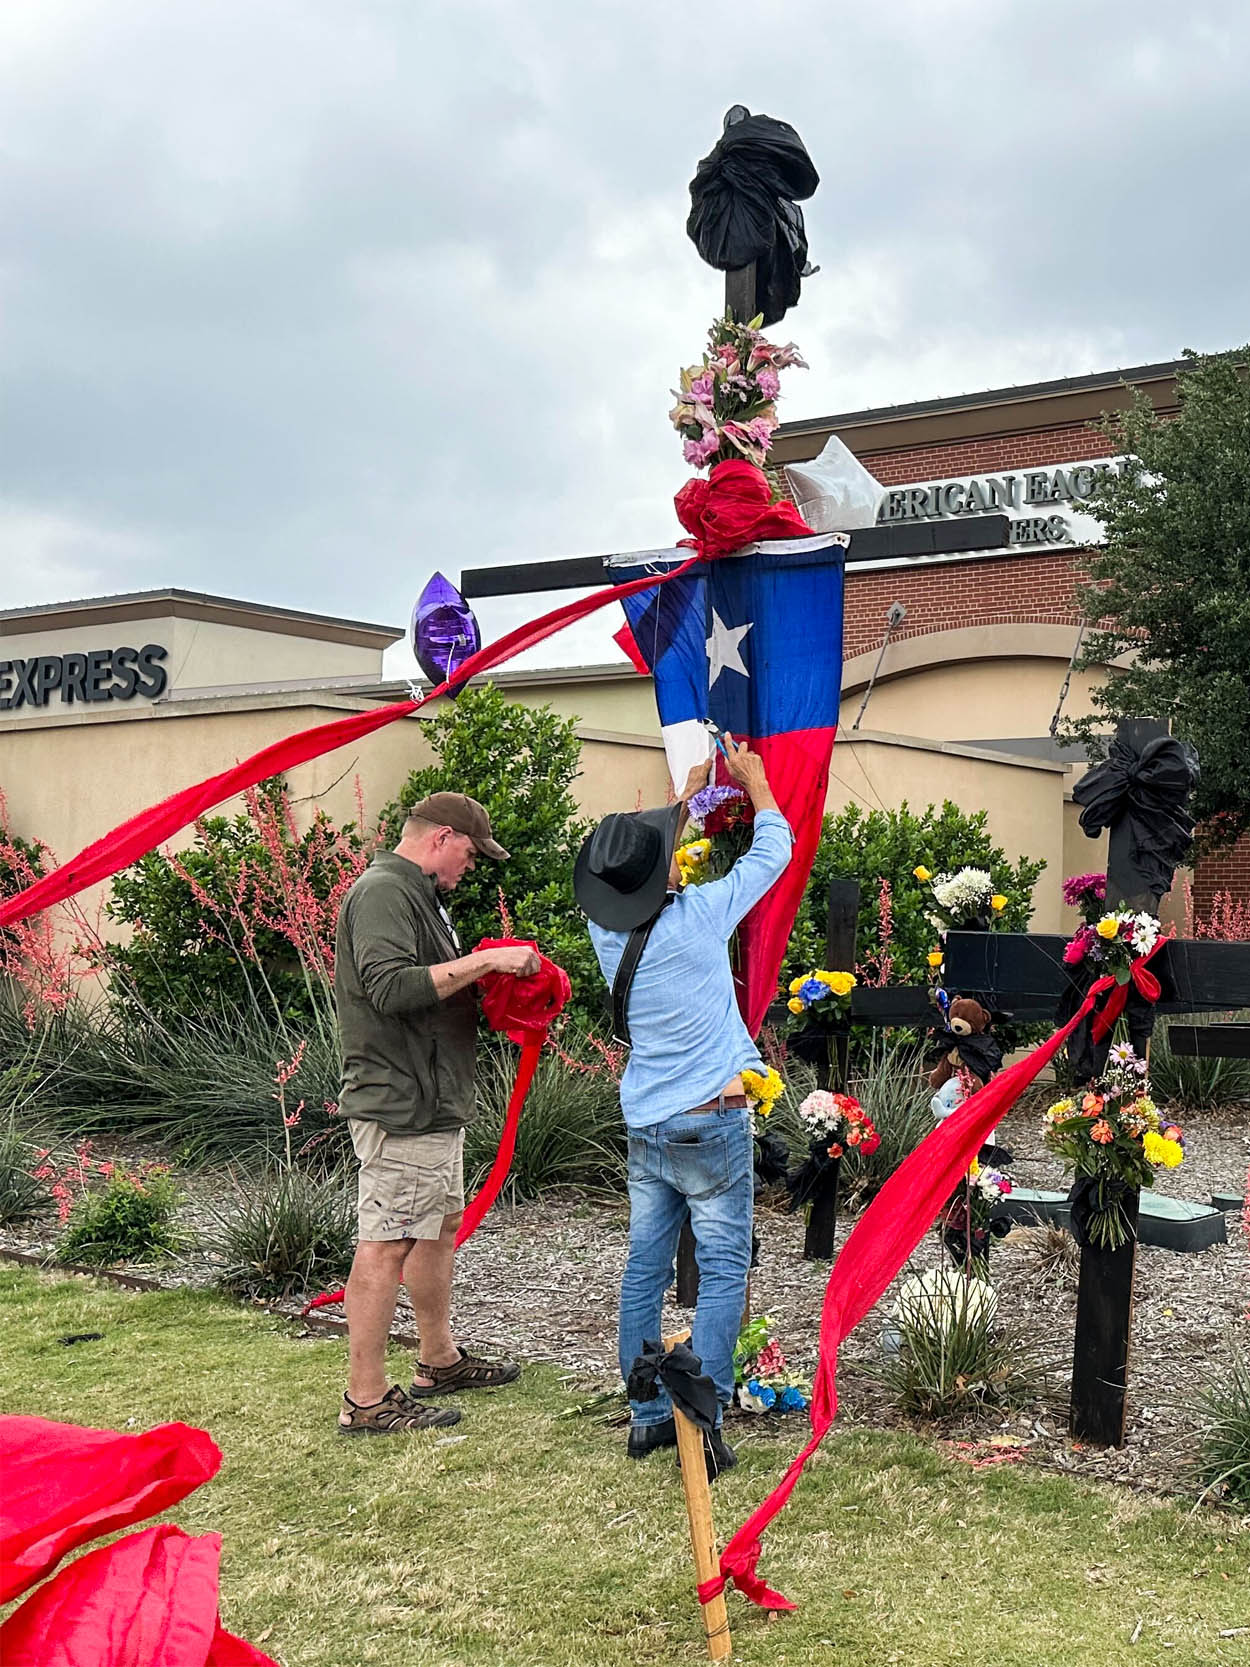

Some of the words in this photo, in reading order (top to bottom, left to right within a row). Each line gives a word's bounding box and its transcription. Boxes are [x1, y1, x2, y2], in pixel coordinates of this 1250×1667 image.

[883, 475, 1016, 522] ERICAN
[1023, 461, 1140, 504] EAG
[1009, 515, 1067, 544] ERS
[0, 644, 168, 709] EXPRESS
